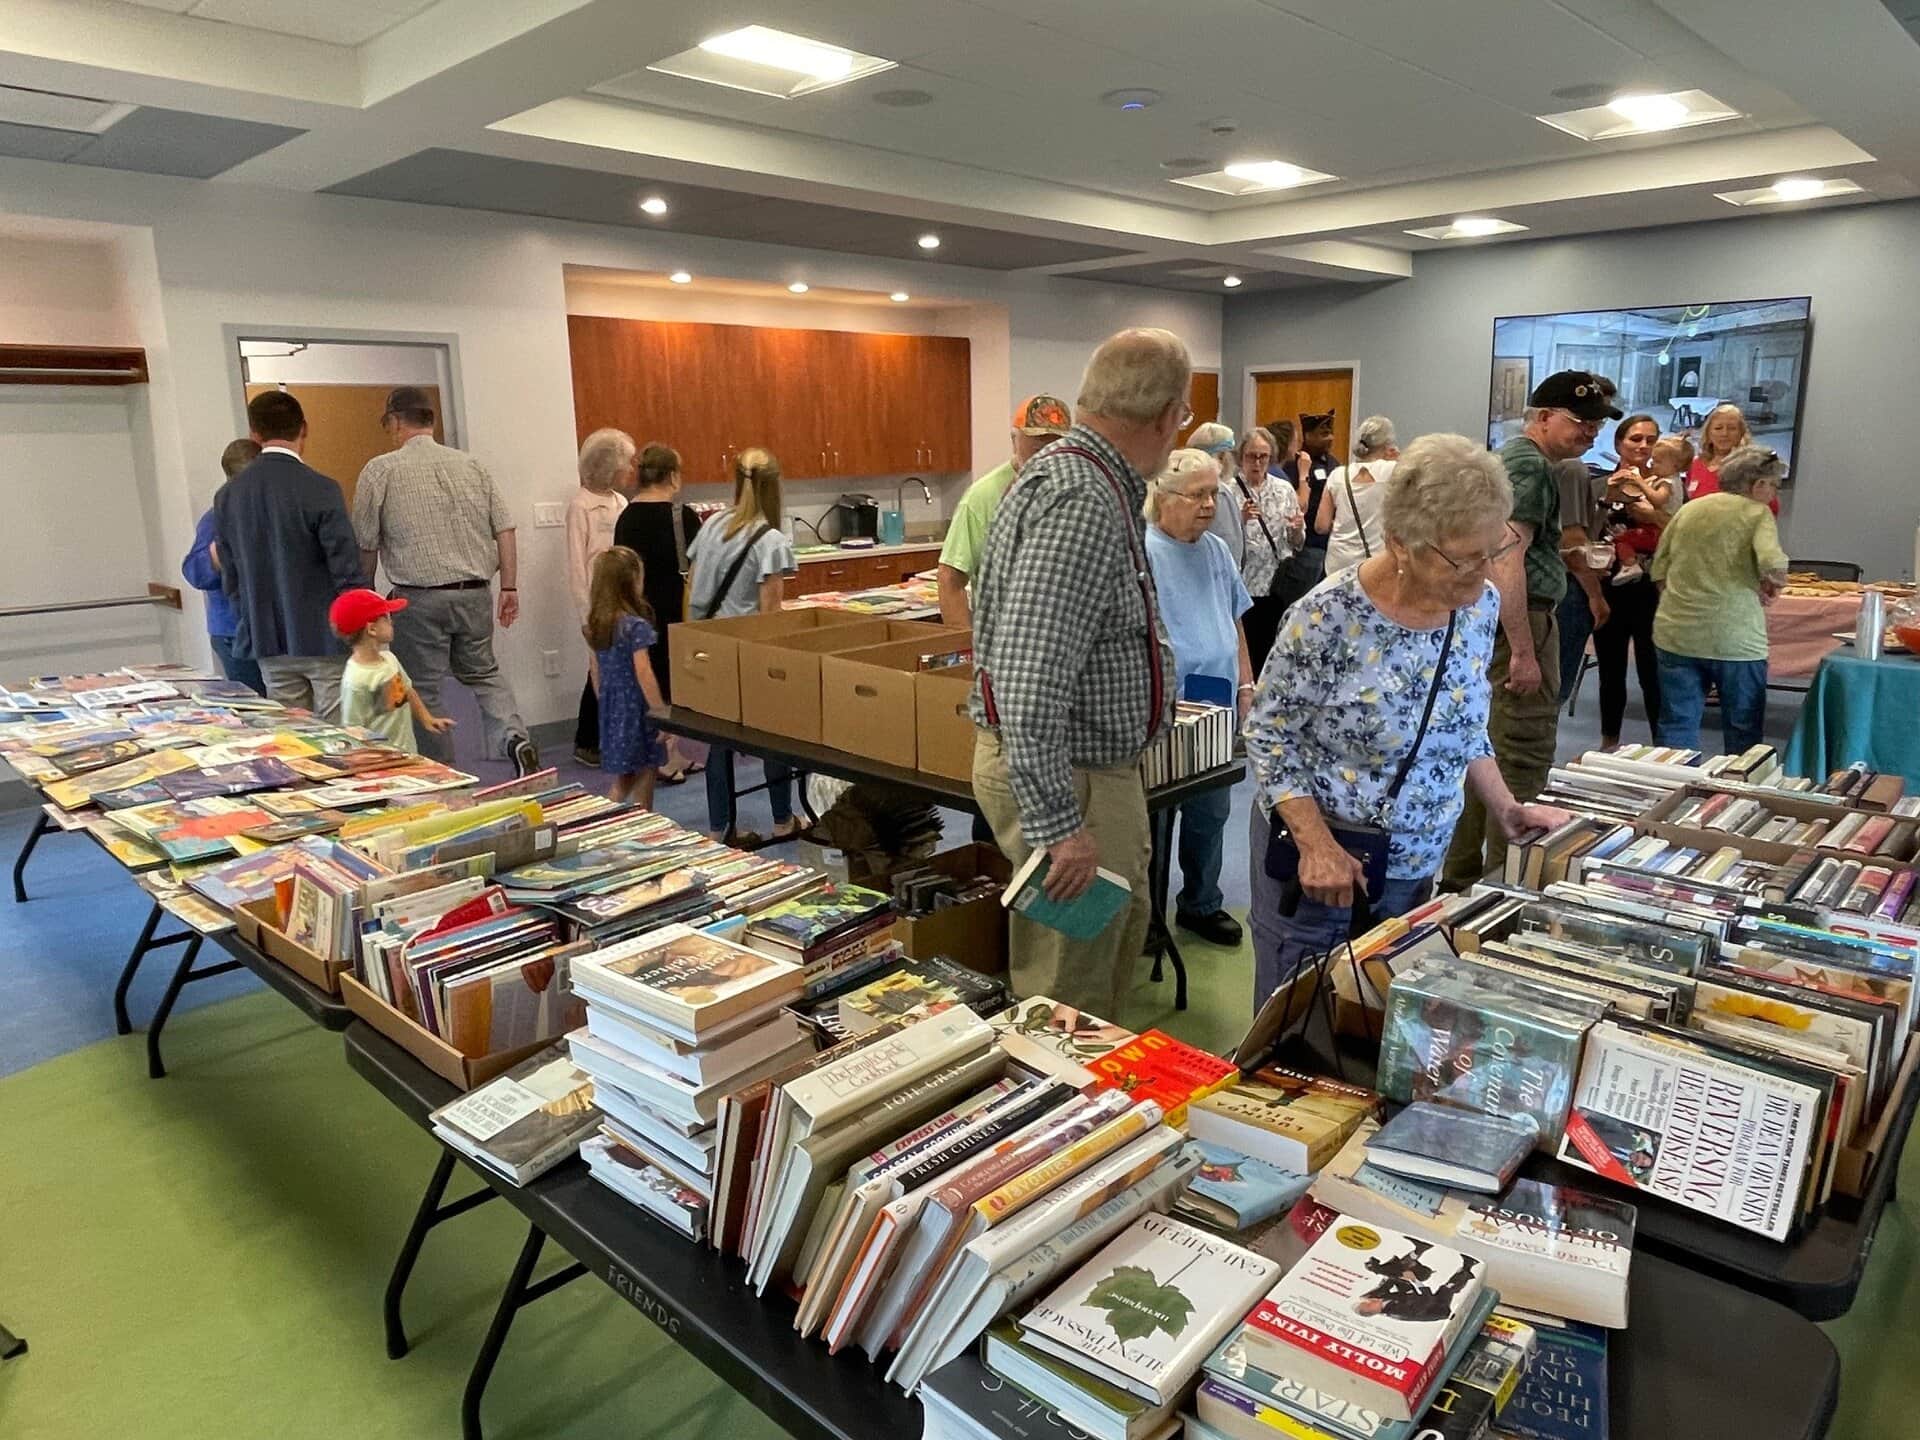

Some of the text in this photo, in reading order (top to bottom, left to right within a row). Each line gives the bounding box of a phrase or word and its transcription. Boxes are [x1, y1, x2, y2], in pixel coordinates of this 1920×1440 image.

[1427, 1028, 1451, 1087] Water
[1453, 1054, 1477, 1082] of
[1485, 1026, 1515, 1117] Covenan
[1519, 1067, 1544, 1107] The
[1672, 1068, 1706, 1127] HEART
[895, 1112, 958, 1150] EXPRESS LANE
[1217, 1101, 1304, 1132] LUCINDA
[1239, 1103, 1295, 1121] RILEY
[1791, 1119, 1799, 1134] NEW
[909, 1152, 949, 1179] FRESH
[951, 1121, 1003, 1154] CHINESE
[1652, 1125, 1694, 1196] DISEASE
[1682, 1078, 1744, 1209] REVERSING
[1730, 1119, 1757, 1186] PROGRAM FOR
[1739, 1094, 1789, 1226] DR. DEAN ORNISH'S
[1786, 1136, 1796, 1156] YORK
[1780, 1158, 1791, 1182] TIMES
[1480, 1205, 1618, 1241] OF TRUST
[1768, 1183, 1785, 1231] BESTSELLER
[1143, 1219, 1266, 1277] GAIL SHEEHY
[608, 1264, 680, 1334] FRIENDS
[1108, 1292, 1170, 1323] menopause
[1038, 1307, 1102, 1346] PASSAGE
[1257, 1311, 1407, 1380] MOLLY IVINS
[1281, 1378, 1376, 1432] STAR
[1513, 1397, 1588, 1427] PEOP
[1526, 1382, 1590, 1411] HIST
